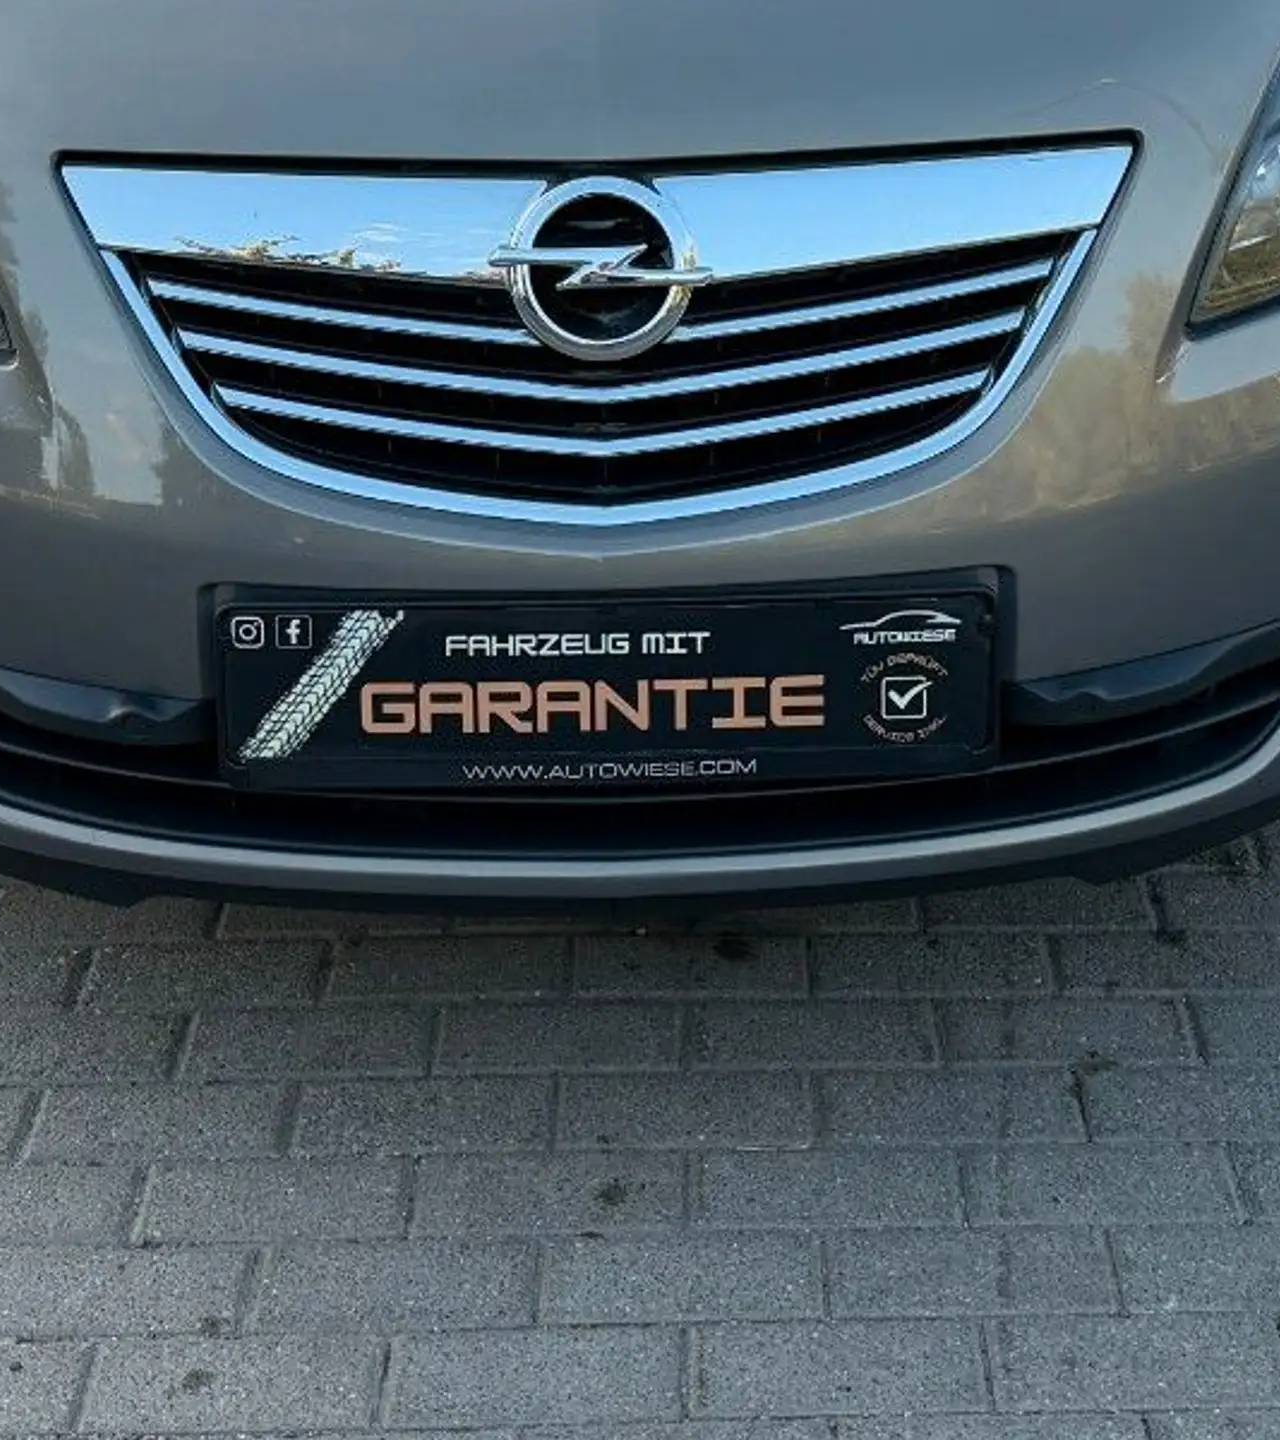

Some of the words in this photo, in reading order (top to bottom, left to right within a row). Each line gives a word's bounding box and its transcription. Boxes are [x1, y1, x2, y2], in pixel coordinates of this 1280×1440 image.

[445, 633, 630, 657] FAHRZEUG
[641, 631, 711, 655] MIT
[853, 628, 957, 645] AUTOWIESE
[360, 674, 826, 734] GARANTIE
[462, 758, 757, 780] WWW.AUTOWIESE.COM
